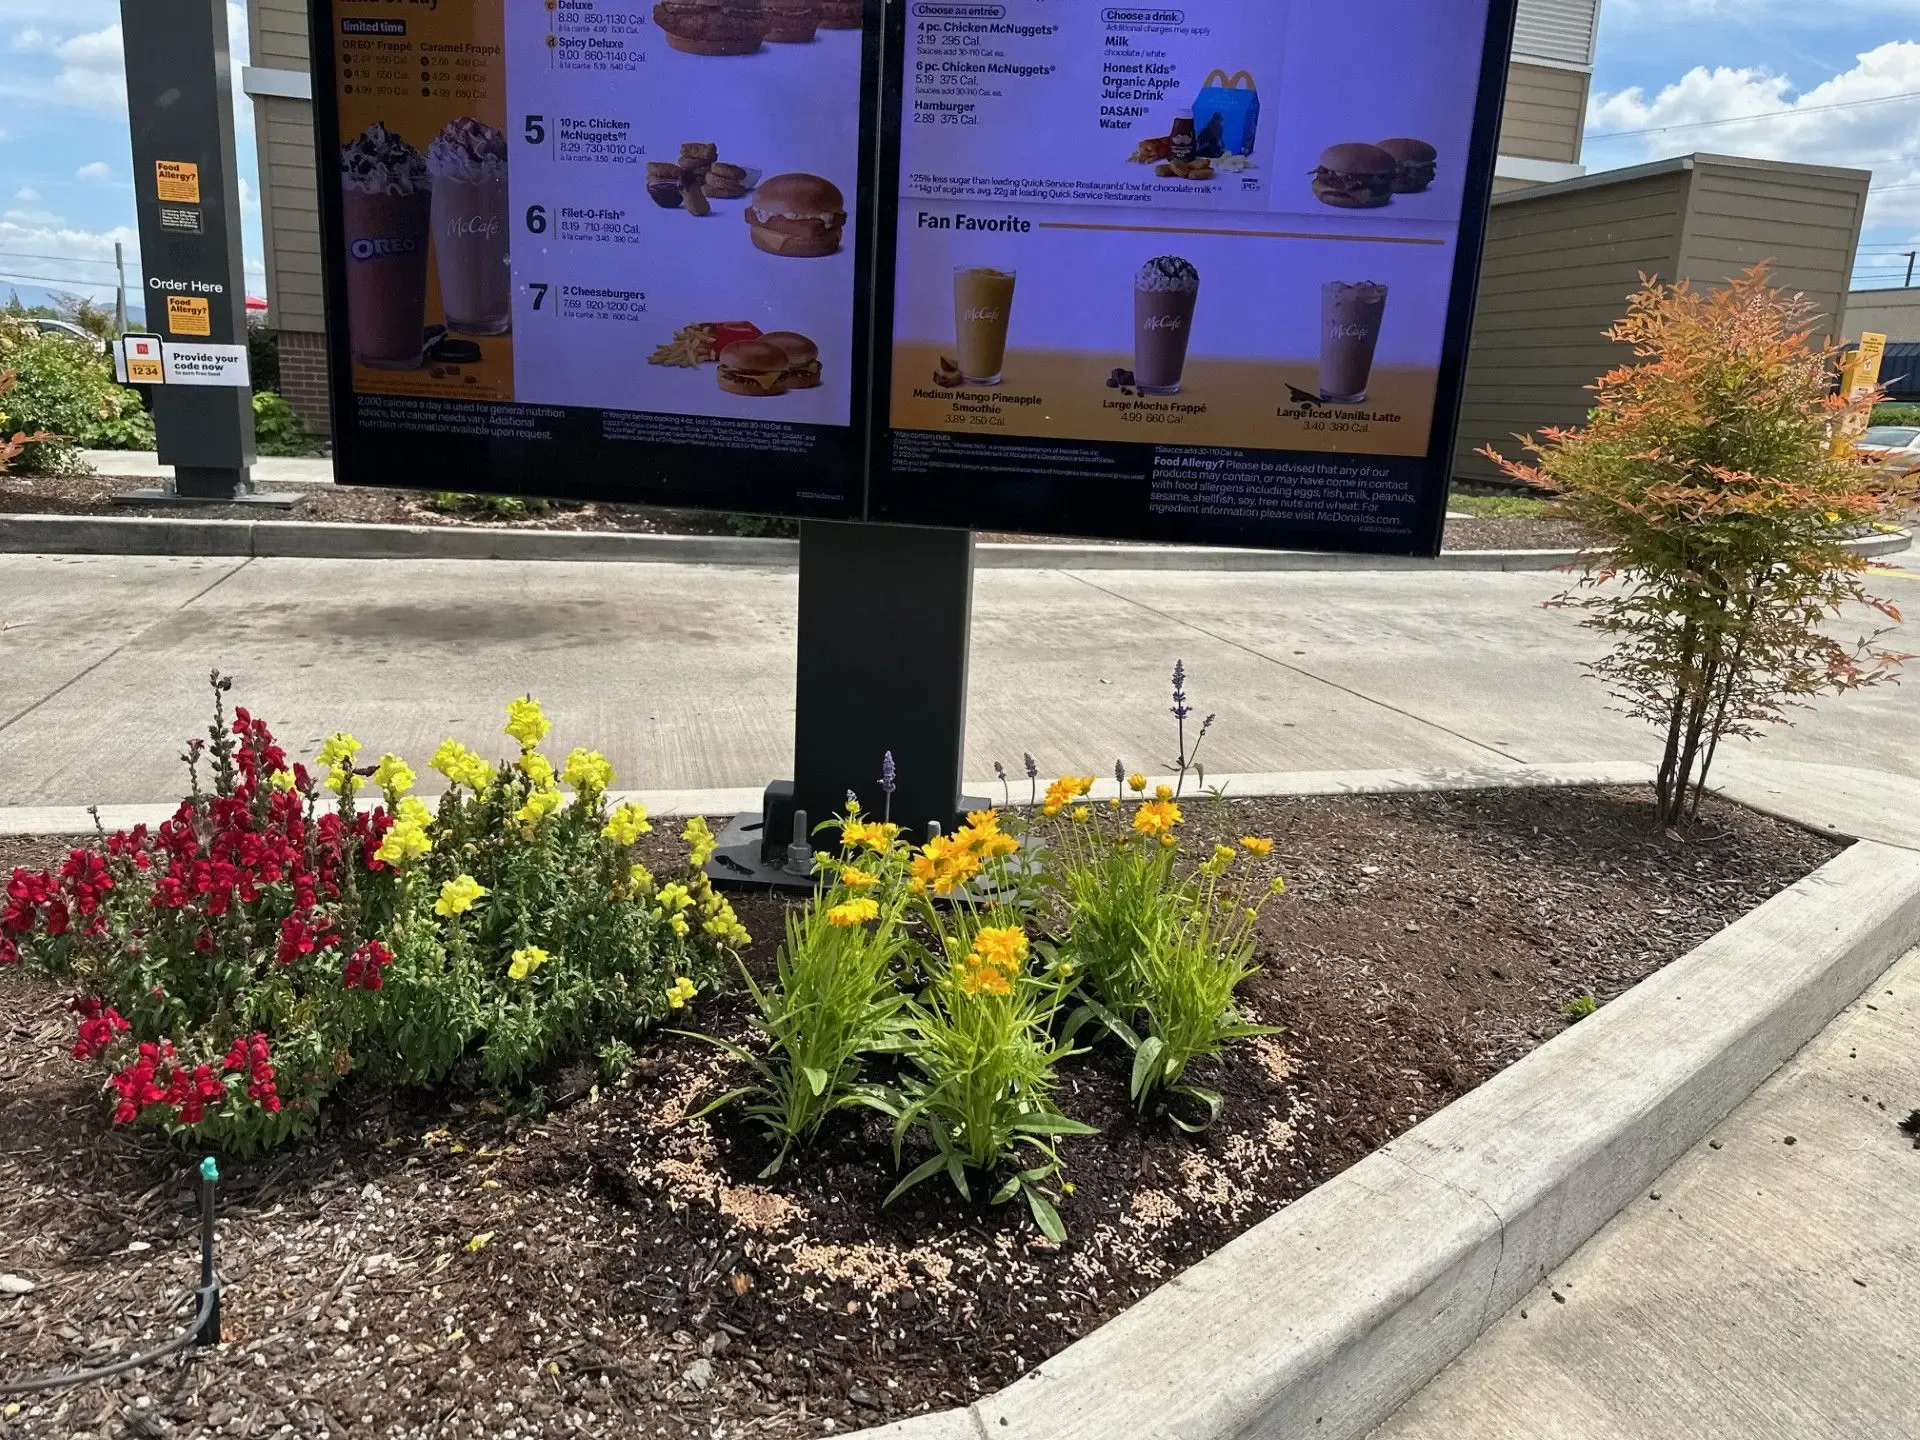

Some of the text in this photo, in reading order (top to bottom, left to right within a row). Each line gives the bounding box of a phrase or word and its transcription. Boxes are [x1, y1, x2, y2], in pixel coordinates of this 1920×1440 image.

[558, 0, 593, 10] Deluxe
[918, 5, 1000, 16] Choose an entrée
[559, 12, 579, 23] 8.80
[584, 14, 627, 24] 850-1130
[1107, 11, 1143, 20] Choose
[1152, 12, 1177, 21] drink
[343, 20, 404, 33] limited time
[917, 22, 925, 31] 4
[944, 22, 988, 33] Chicken
[559, 37, 587, 50] Spicy
[589, 38, 625, 49] Deluxe
[917, 35, 936, 45] 3.19
[1105, 36, 1129, 46] Milk
[559, 50, 579, 60] 9.00
[584, 51, 627, 61] 860-1140
[915, 62, 923, 71] 6
[942, 62, 986, 73] Chicken
[1103, 63, 1144, 73] Honest
[915, 74, 934, 84] 5.19
[940, 75, 958, 85] 375
[1102, 76, 1180, 89] Organic Apple
[1101, 88, 1164, 101] Juice Drink
[914, 100, 975, 114] Hamburger
[560, 118, 571, 127] 10
[588, 119, 630, 129] Chicken
[913, 113, 935, 124] 2.89
[940, 114, 958, 124] 375
[1099, 118, 1132, 129] Water
[525, 115, 545, 144] 5
[560, 142, 581, 152] 8.29
[584, 143, 627, 154] 730-1010
[158, 163, 180, 171] Food
[159, 171, 196, 182] Allergy?
[526, 205, 547, 234] 6
[918, 212, 1031, 233] Fan Favorite
[561, 221, 580, 231] 8.19
[584, 222, 621, 233] 710-990
[350, 237, 417, 261] OREO
[150, 277, 223, 293] Order Here
[529, 283, 549, 311] 7
[563, 286, 646, 301] 2 Cheeseburgers
[169, 298, 191, 306] Food
[563, 299, 582, 309] 7.69
[586, 300, 629, 311] 920-1200
[170, 305, 207, 316] Allergy?
[173, 353, 239, 364] Provide your
[132, 367, 158, 376] 12 34
[174, 362, 224, 371] code now
[913, 389, 1043, 406] Medium Mango Pineapple
[952, 402, 1002, 414] Smoothie
[1103, 399, 1207, 414] Large Mocha Frappé
[945, 414, 965, 424] 3.89
[969, 415, 988, 425] 250
[1120, 412, 1143, 422] 4.99
[1145, 413, 1165, 423] 660
[1277, 407, 1401, 422] Large Iced Vanilla Latte
[1303, 421, 1325, 431] 3.40
[1154, 456, 1391, 478] Food Allergy? Please be advised that any of our
[1152, 469, 1198, 479] products
[1199, 472, 1221, 482] may
[1263, 475, 1275, 483] or
[1276, 476, 1298, 487] may
[1300, 476, 1325, 486] have
[1326, 478, 1356, 487] come
[1358, 478, 1367, 488] in
[1368, 480, 1409, 490] contact
[1151, 480, 1173, 488] with
[1175, 480, 1198, 490] food
[1199, 482, 1245, 495] allergens
[1246, 484, 1292, 498] including
[1293, 489, 1321, 499] eggs,
[1259, 497, 1279, 506] tree
[1280, 500, 1303, 508] nuts
[1304, 500, 1325, 509] and
[1362, 502, 1380, 512] For
[1149, 503, 1200, 514] ingredient
[1201, 505, 1259, 517] information
[1260, 508, 1294, 519] please
[1295, 510, 1315, 520] visit
